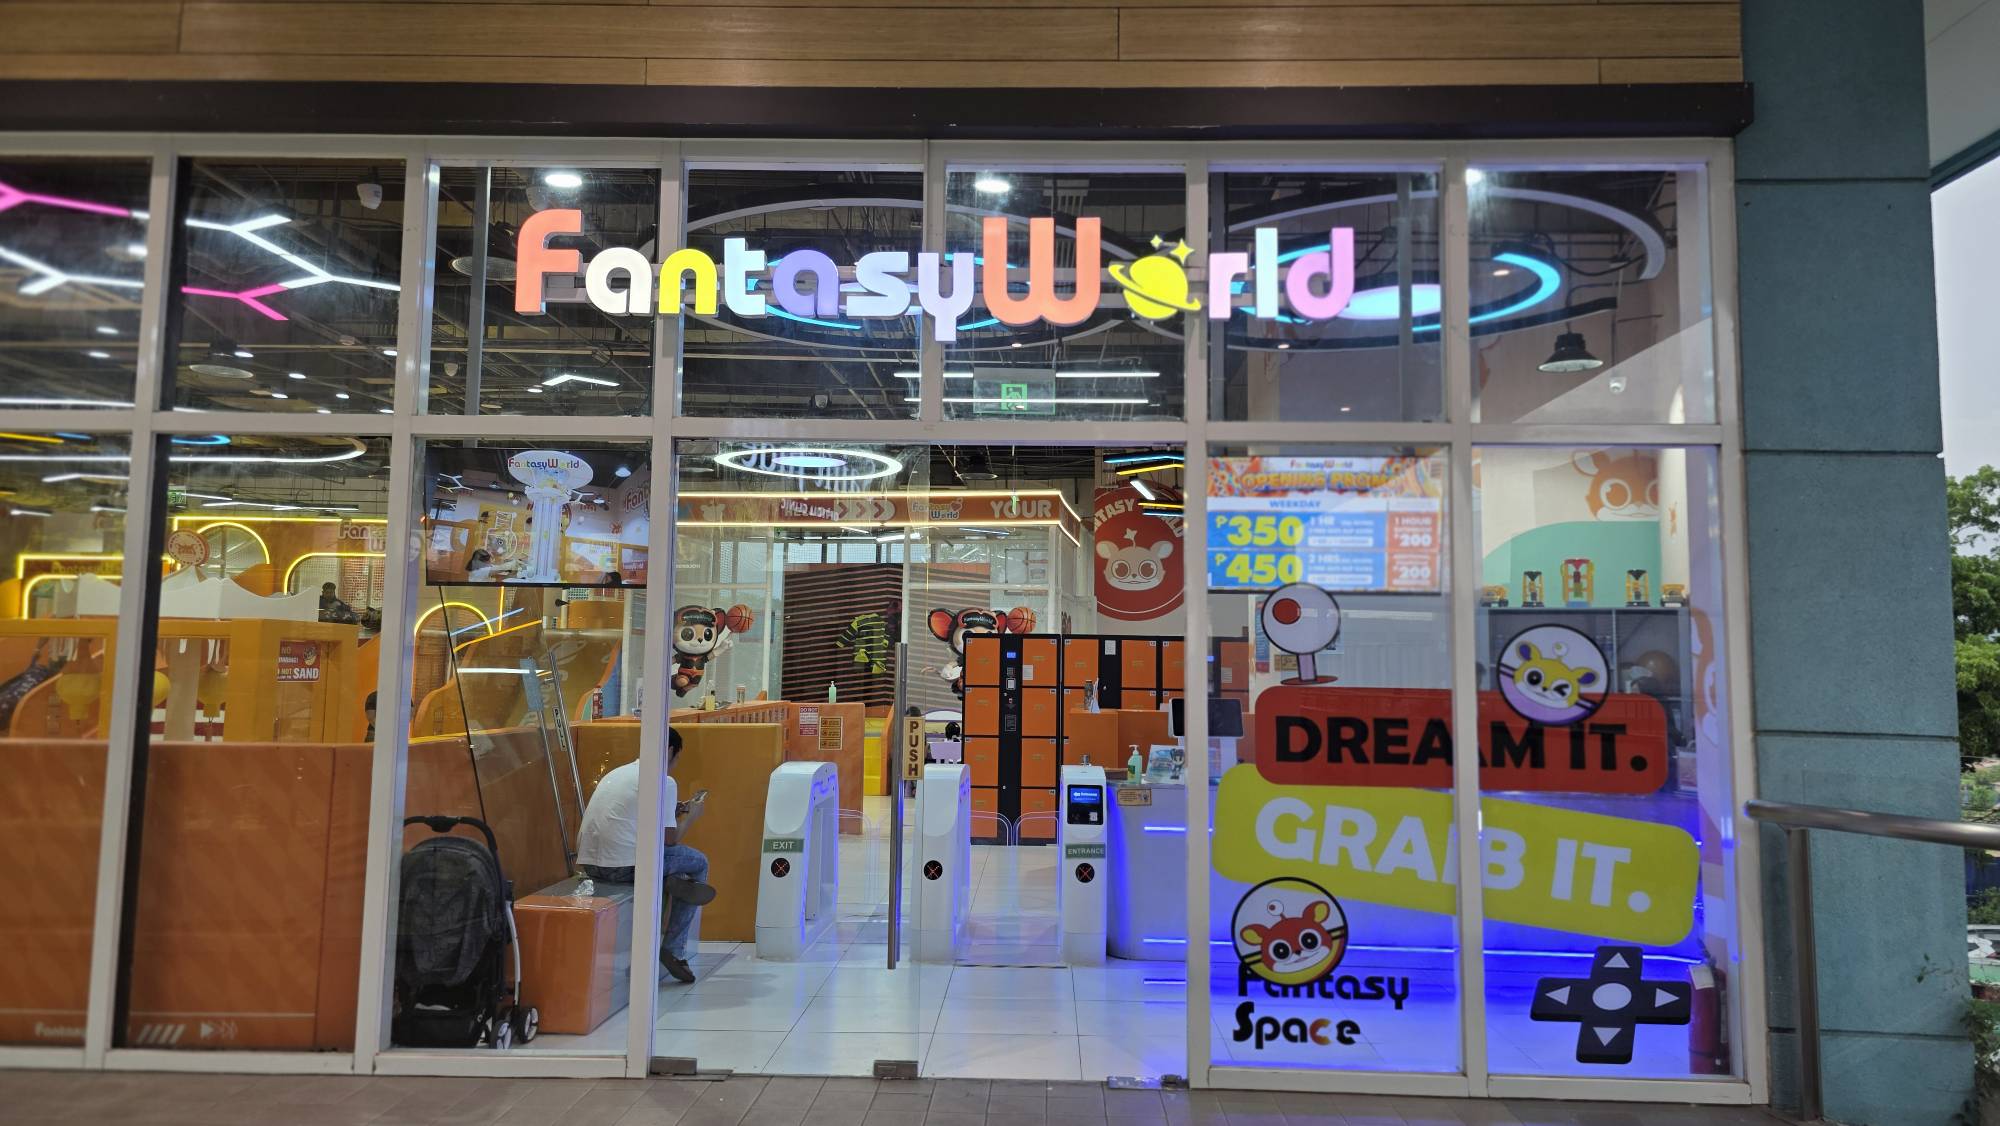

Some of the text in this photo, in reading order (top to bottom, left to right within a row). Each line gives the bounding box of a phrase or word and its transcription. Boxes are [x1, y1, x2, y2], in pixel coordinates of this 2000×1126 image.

[990, 500, 1051, 519] YOUR
[293, 667, 319, 679] SAND
[908, 720, 919, 776] PUSH
[1275, 715, 1648, 772] DREAM IT.
[772, 841, 794, 850] EXIT
[1067, 847, 1105, 855] ENTRANCE
[1255, 796, 1651, 913] GRAB IT.
[1233, 1001, 1361, 1050] Space
